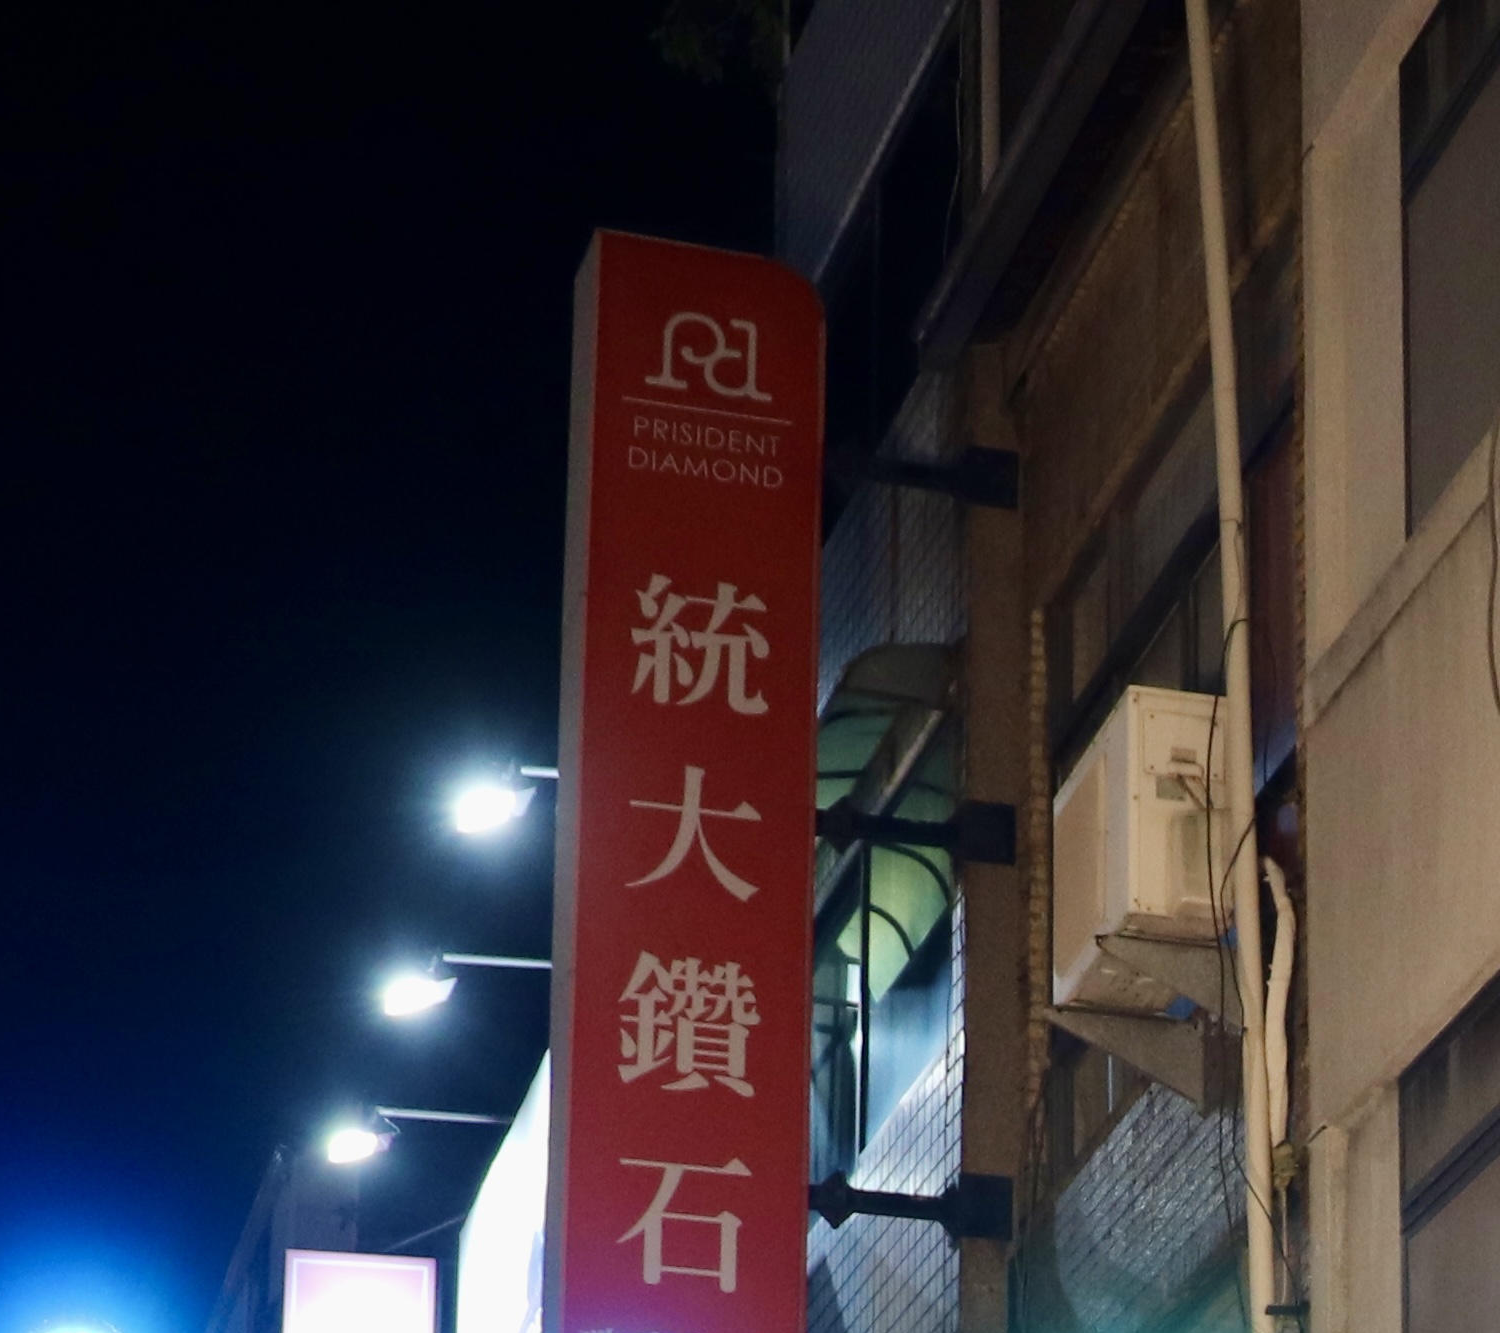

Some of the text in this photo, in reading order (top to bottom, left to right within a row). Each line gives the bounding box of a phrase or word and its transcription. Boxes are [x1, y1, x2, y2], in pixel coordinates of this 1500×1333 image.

[632, 415, 781, 457] PRISIDENT
[627, 446, 783, 488] DIAMOND
[614, 572, 770, 1296] 統大鑽石
